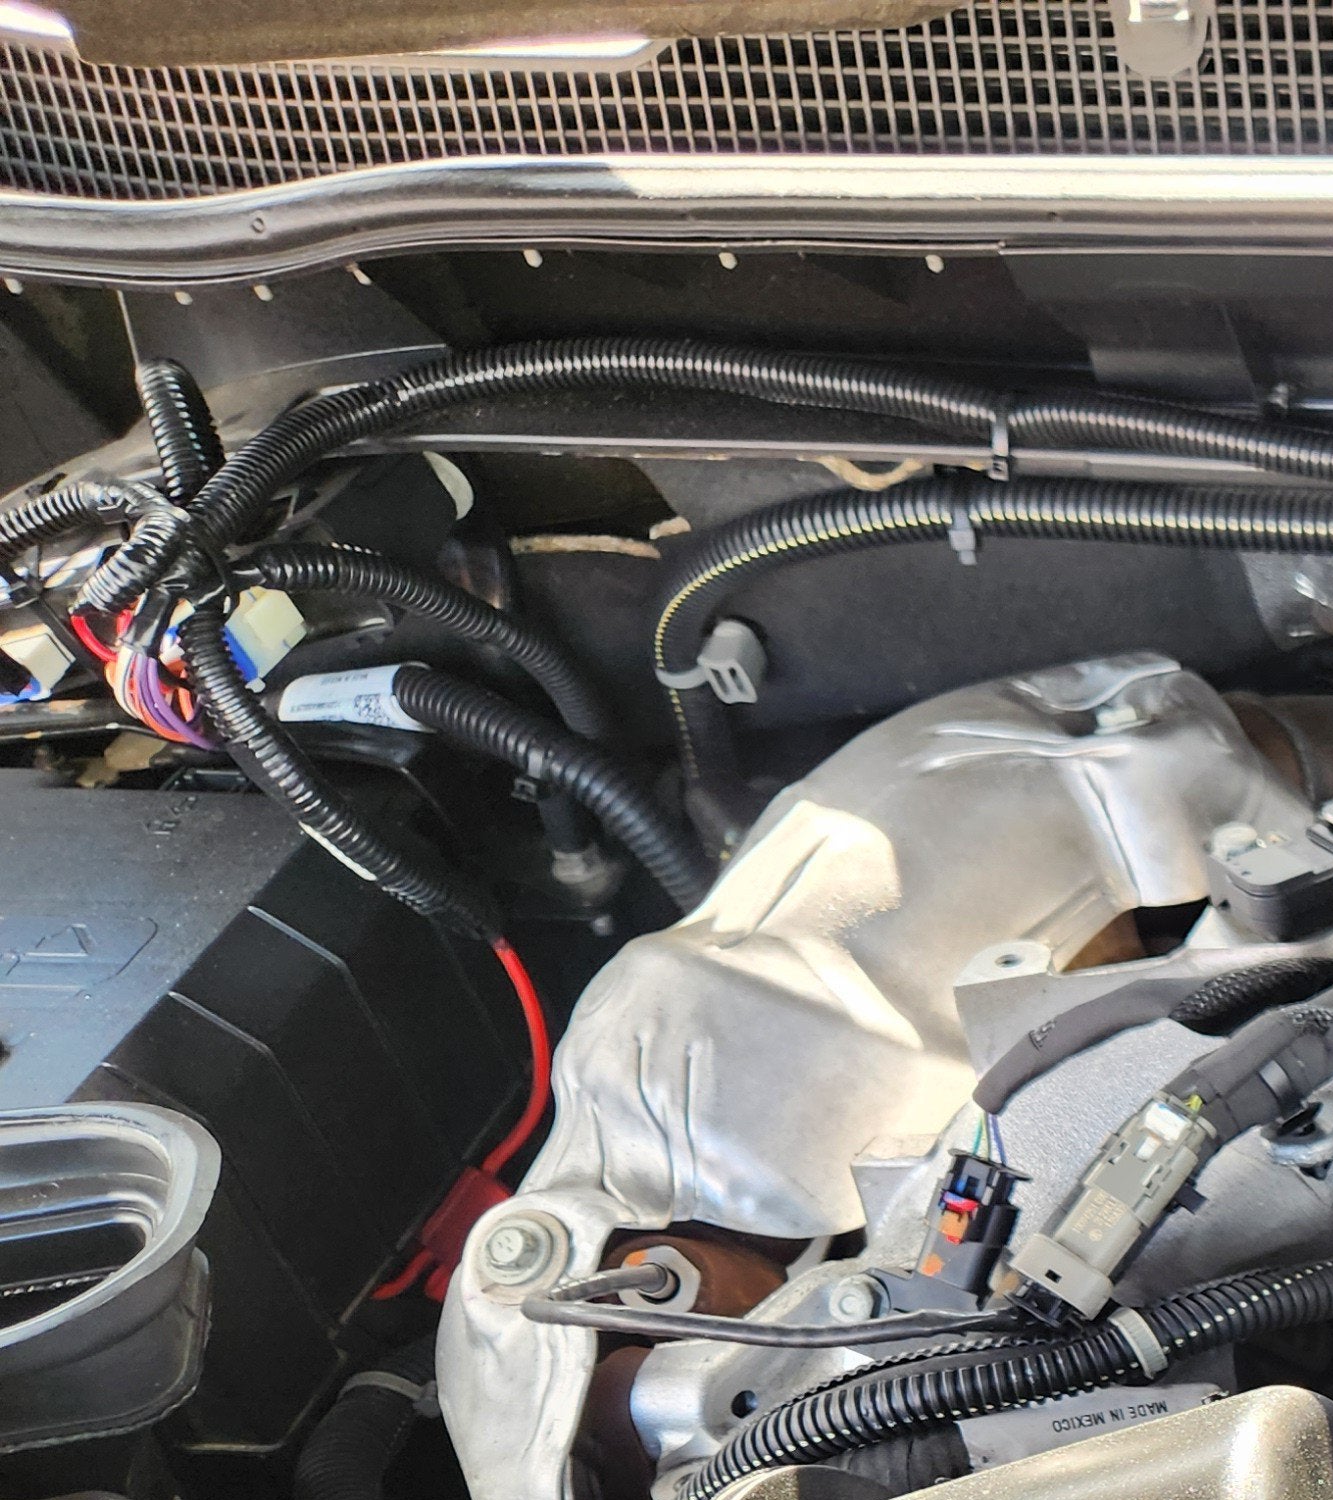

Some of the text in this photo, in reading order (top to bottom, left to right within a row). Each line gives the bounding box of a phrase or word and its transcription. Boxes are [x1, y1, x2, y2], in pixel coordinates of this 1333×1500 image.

[1052, 1401, 1168, 1433] MADE IN MEXICO
